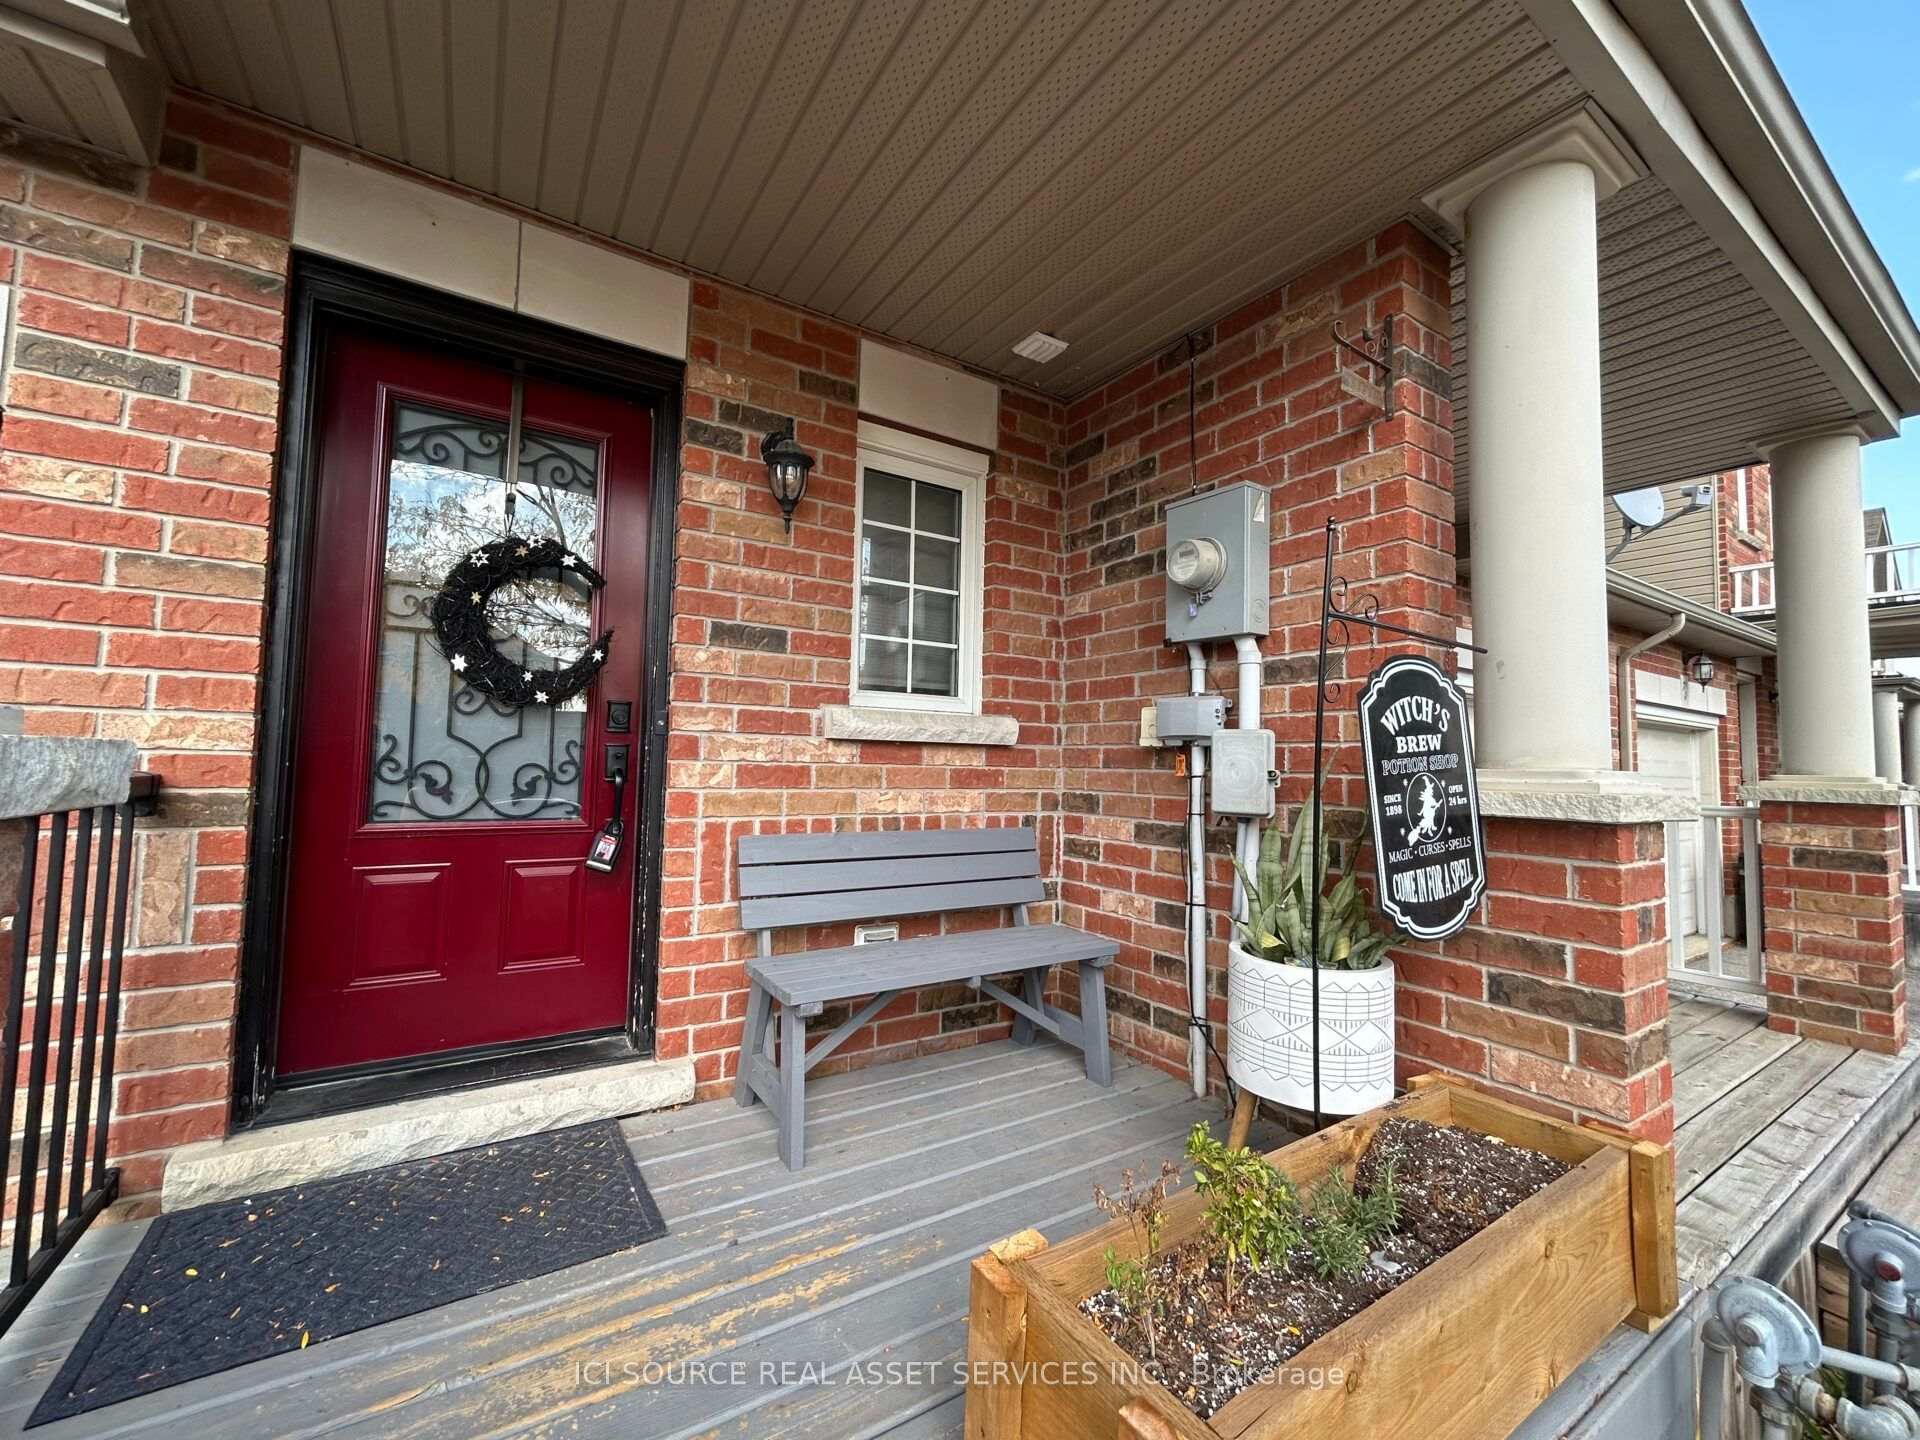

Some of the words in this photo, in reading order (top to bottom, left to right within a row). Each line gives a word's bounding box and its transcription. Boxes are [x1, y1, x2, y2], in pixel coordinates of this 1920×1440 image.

[1380, 695, 1451, 735] WITCH'S
[1395, 733, 1442, 754] BREW
[1381, 756, 1428, 776] POTION
[1429, 753, 1459, 771] SHOP
[1383, 793, 1402, 804] SINCE
[1448, 783, 1464, 794] OPEN
[1457, 795, 1468, 805] hrs
[1388, 847, 1414, 864] MAGIC
[1418, 841, 1446, 857] CURSES
[1448, 836, 1472, 851] SPELLS
[1392, 870, 1418, 903] COME
[1416, 868, 1428, 903] IN
[1426, 864, 1445, 902] FOR
[1444, 863, 1452, 897] A
[1450, 857, 1474, 894] SPELL
